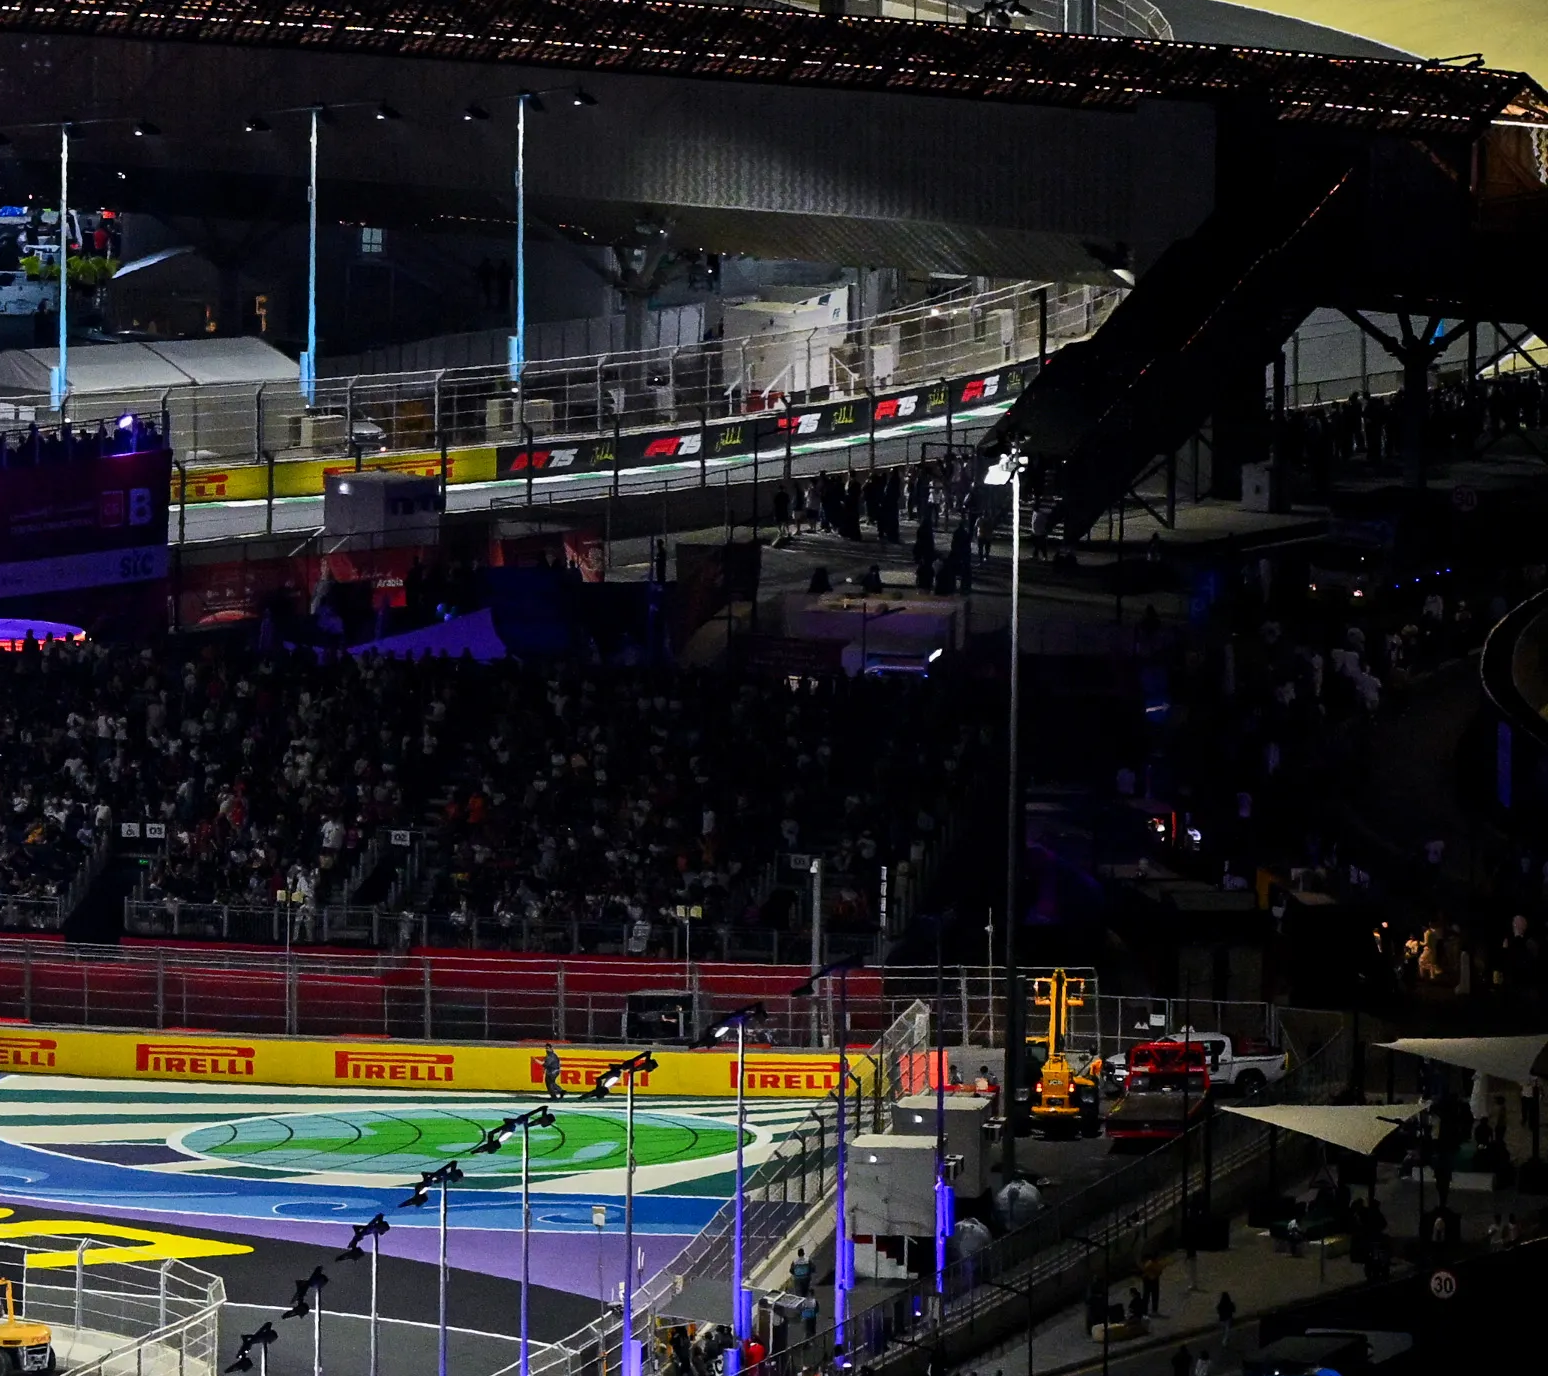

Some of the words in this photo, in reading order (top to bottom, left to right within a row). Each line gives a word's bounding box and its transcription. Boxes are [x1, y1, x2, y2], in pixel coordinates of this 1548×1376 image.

[894, 395, 918, 416] 75
[676, 435, 703, 455] 75
[120, 550, 154, 578] stc
[136, 1043, 255, 1075] PIRELLI
[334, 1050, 454, 1082] PIRELLI
[1436, 1276, 1455, 1293] 30
